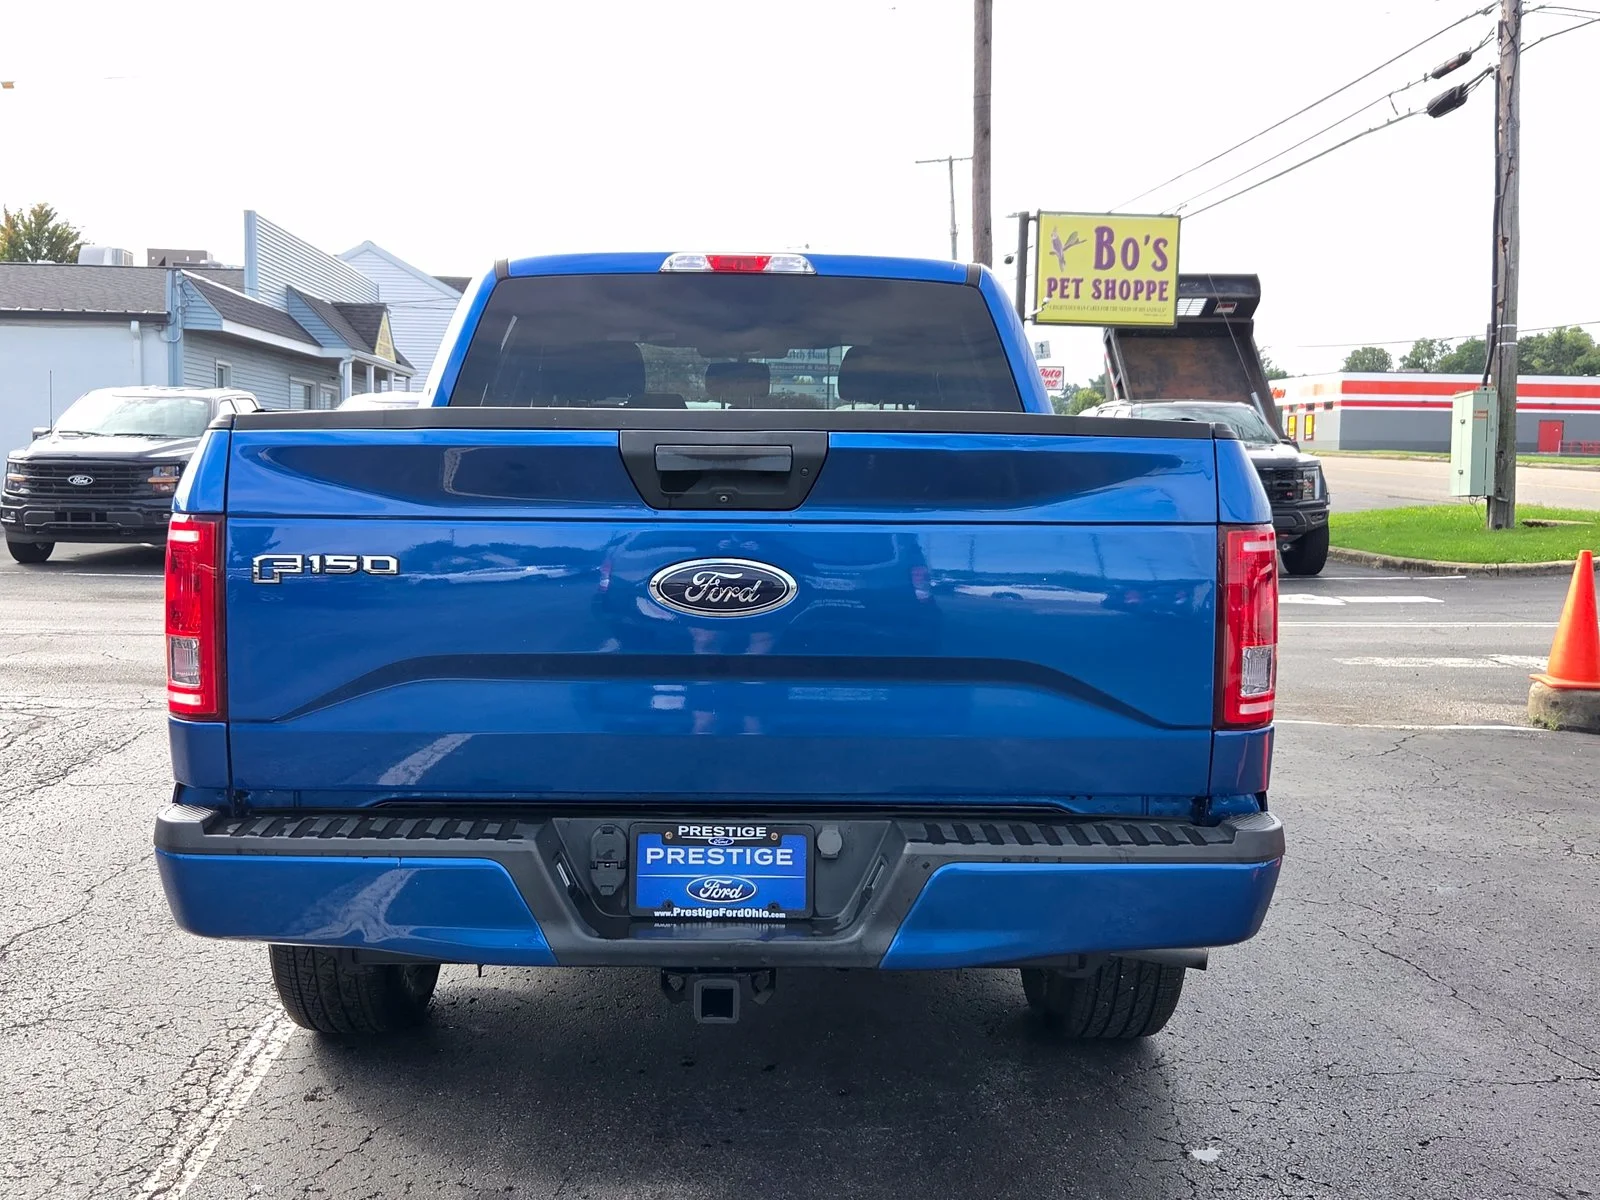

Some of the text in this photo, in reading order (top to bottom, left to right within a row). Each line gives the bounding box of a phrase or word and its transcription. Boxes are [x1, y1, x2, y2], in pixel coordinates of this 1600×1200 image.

[1046, 277, 1169, 302] PET SHOPPE
[684, 571, 763, 603] Ford
[678, 825, 767, 837] PRESTIGE
[646, 847, 794, 866] PRESTIGE
[699, 878, 743, 899] Ford
[653, 907, 786, 919] www.PrestigeFordOhio.com
